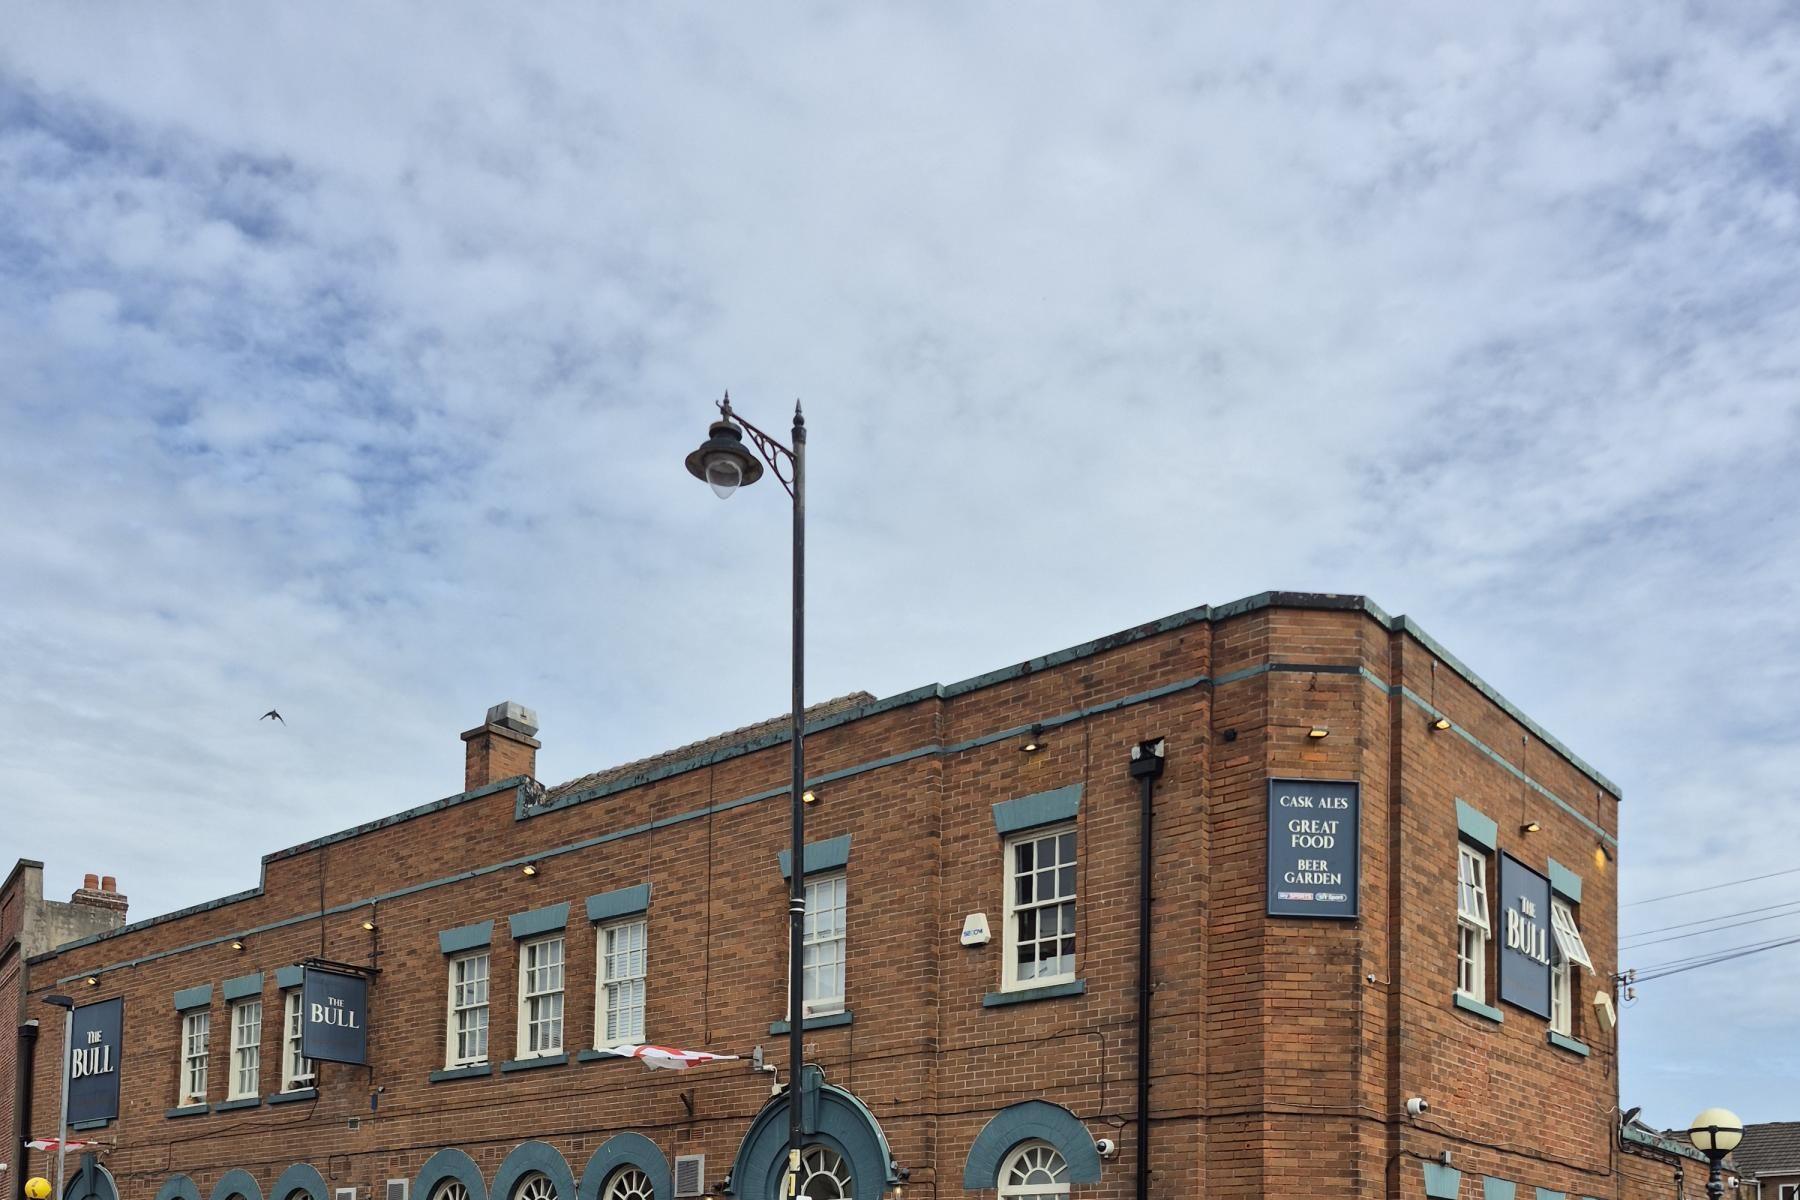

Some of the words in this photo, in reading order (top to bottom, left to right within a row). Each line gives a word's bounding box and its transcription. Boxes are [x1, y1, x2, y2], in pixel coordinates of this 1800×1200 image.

[1280, 795, 1313, 808] CASK
[1318, 797, 1348, 809] ALES
[1288, 819, 1339, 834] GREAT
[1291, 834, 1335, 849] FOOD
[1297, 858, 1328, 871] BEER
[1284, 871, 1342, 885] GARDEN
[1520, 896, 1536, 918] THE
[1507, 907, 1550, 966] BULL
[327, 996, 344, 1008] THE
[311, 1003, 360, 1029] BULL
[87, 1030, 103, 1044] THE
[72, 1045, 114, 1079] BULL
